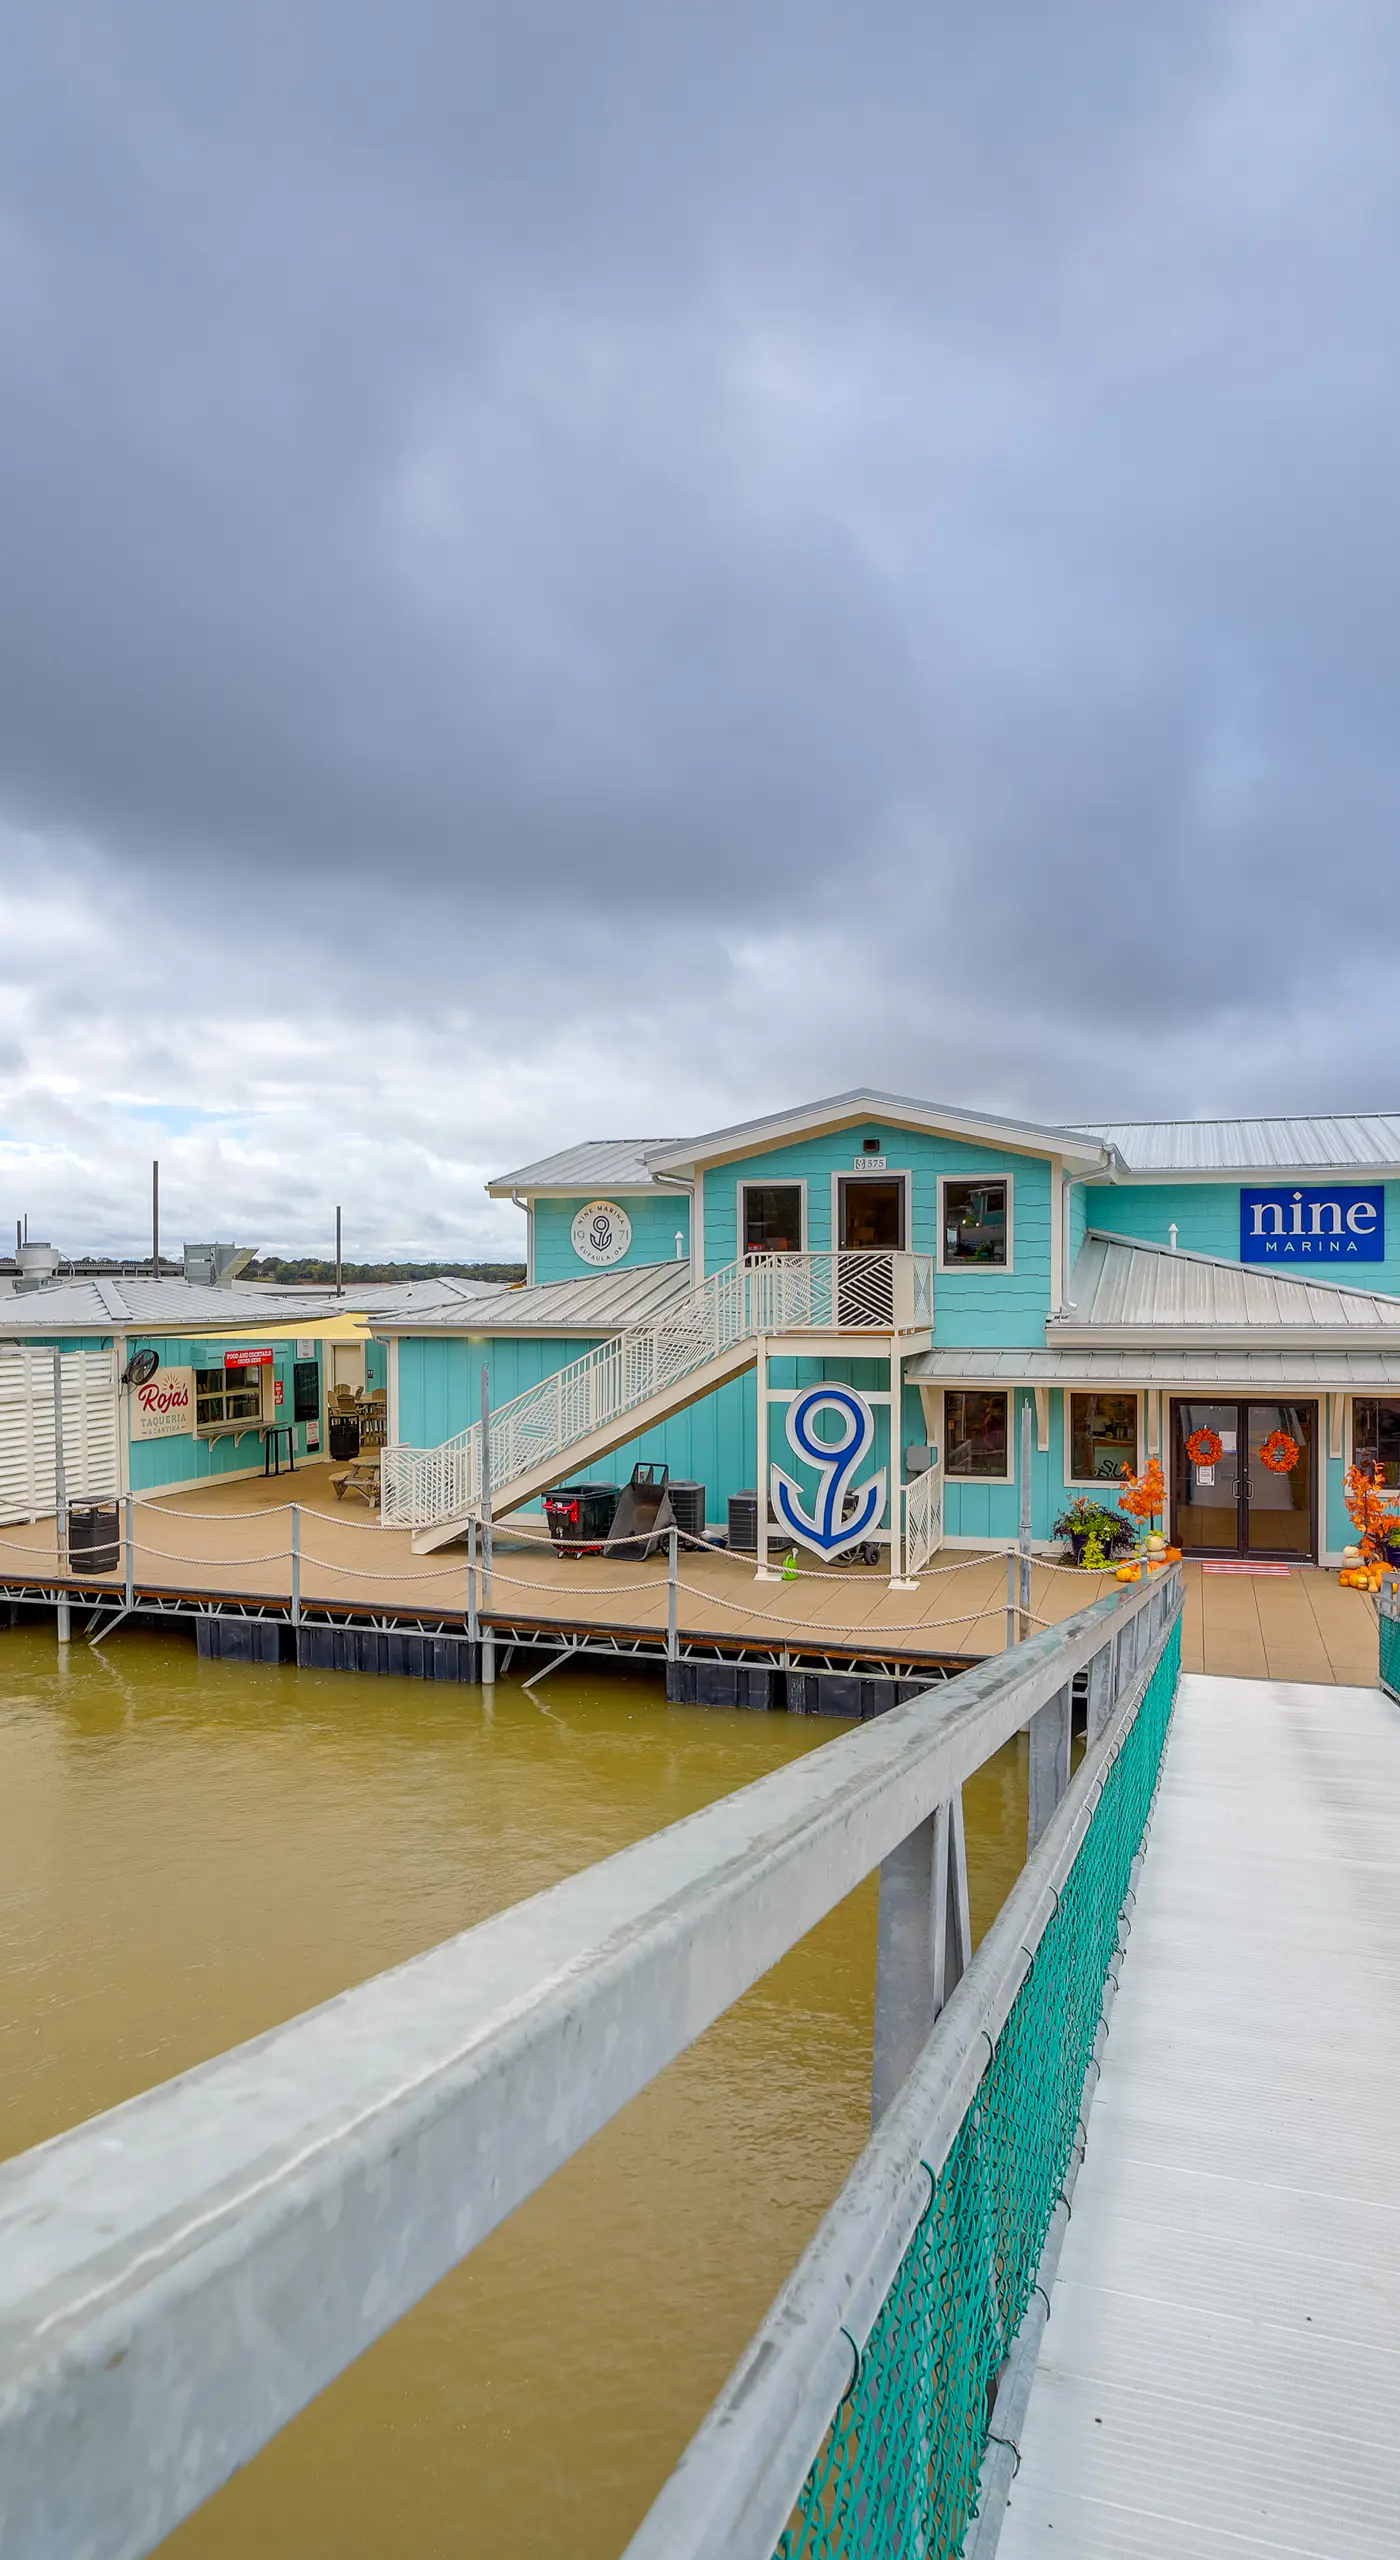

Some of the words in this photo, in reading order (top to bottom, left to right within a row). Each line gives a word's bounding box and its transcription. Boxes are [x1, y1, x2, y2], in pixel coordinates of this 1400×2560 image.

[867, 1159, 884, 1168] 575
[578, 1208, 594, 1225] NINE
[597, 1205, 625, 1225] MARINA
[1250, 1191, 1378, 1235] nine
[614, 1245, 623, 1256] OK
[1266, 1241, 1358, 1252] MARINA
[140, 1413, 187, 1428] TAQUERIA
[153, 1425, 180, 1434] CANTINA
